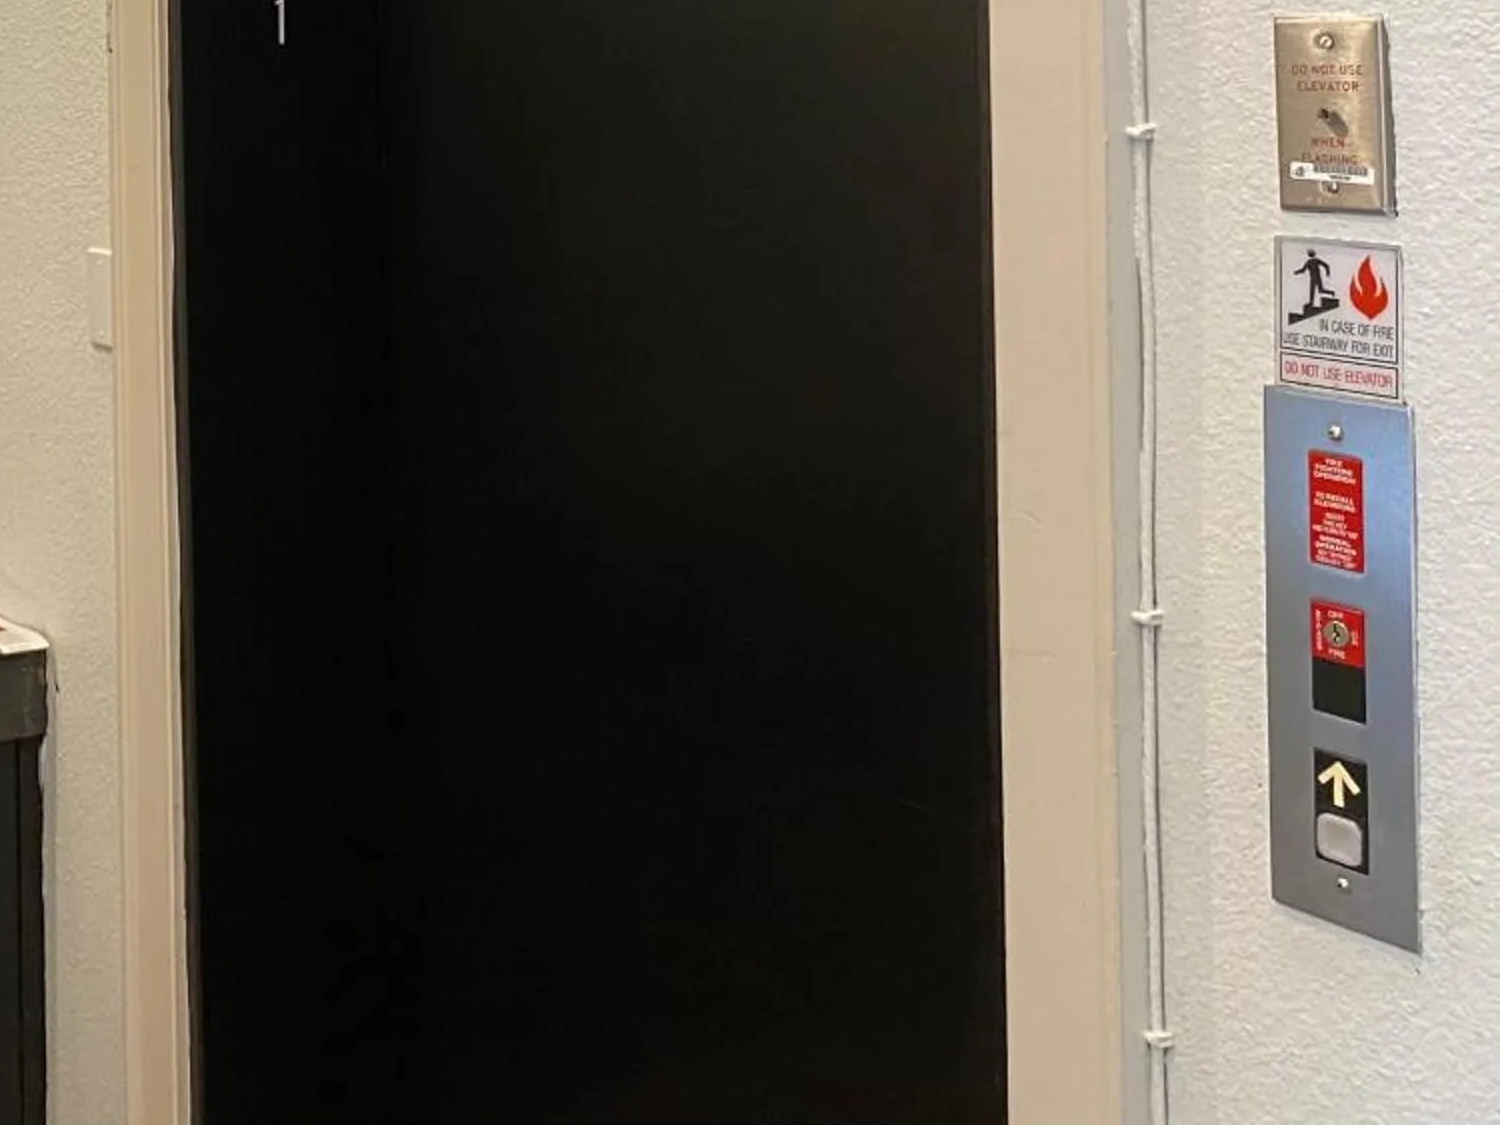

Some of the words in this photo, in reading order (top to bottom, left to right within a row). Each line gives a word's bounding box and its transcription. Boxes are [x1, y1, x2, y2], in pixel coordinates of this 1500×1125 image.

[1291, 64, 1308, 76] DO
[1311, 64, 1336, 76] NOT
[1339, 64, 1363, 76] USE
[1297, 80, 1360, 92] ELEVATOR
[1310, 137, 1346, 148] WHEN
[1319, 318, 1329, 332] IN
[1331, 320, 1355, 335] CASE
[1358, 323, 1370, 337] OF
[1373, 325, 1394, 340] FIRE
[1283, 332, 1300, 345] USE
[1302, 334, 1349, 351] STAIRWAY
[1350, 340, 1371, 354] FOR
[1373, 342, 1393, 358] EXIT
[1284, 360, 1299, 375] DO
[1301, 364, 1319, 378] NOT
[1322, 366, 1342, 381] USE
[1345, 370, 1393, 388] ELEVATOR
